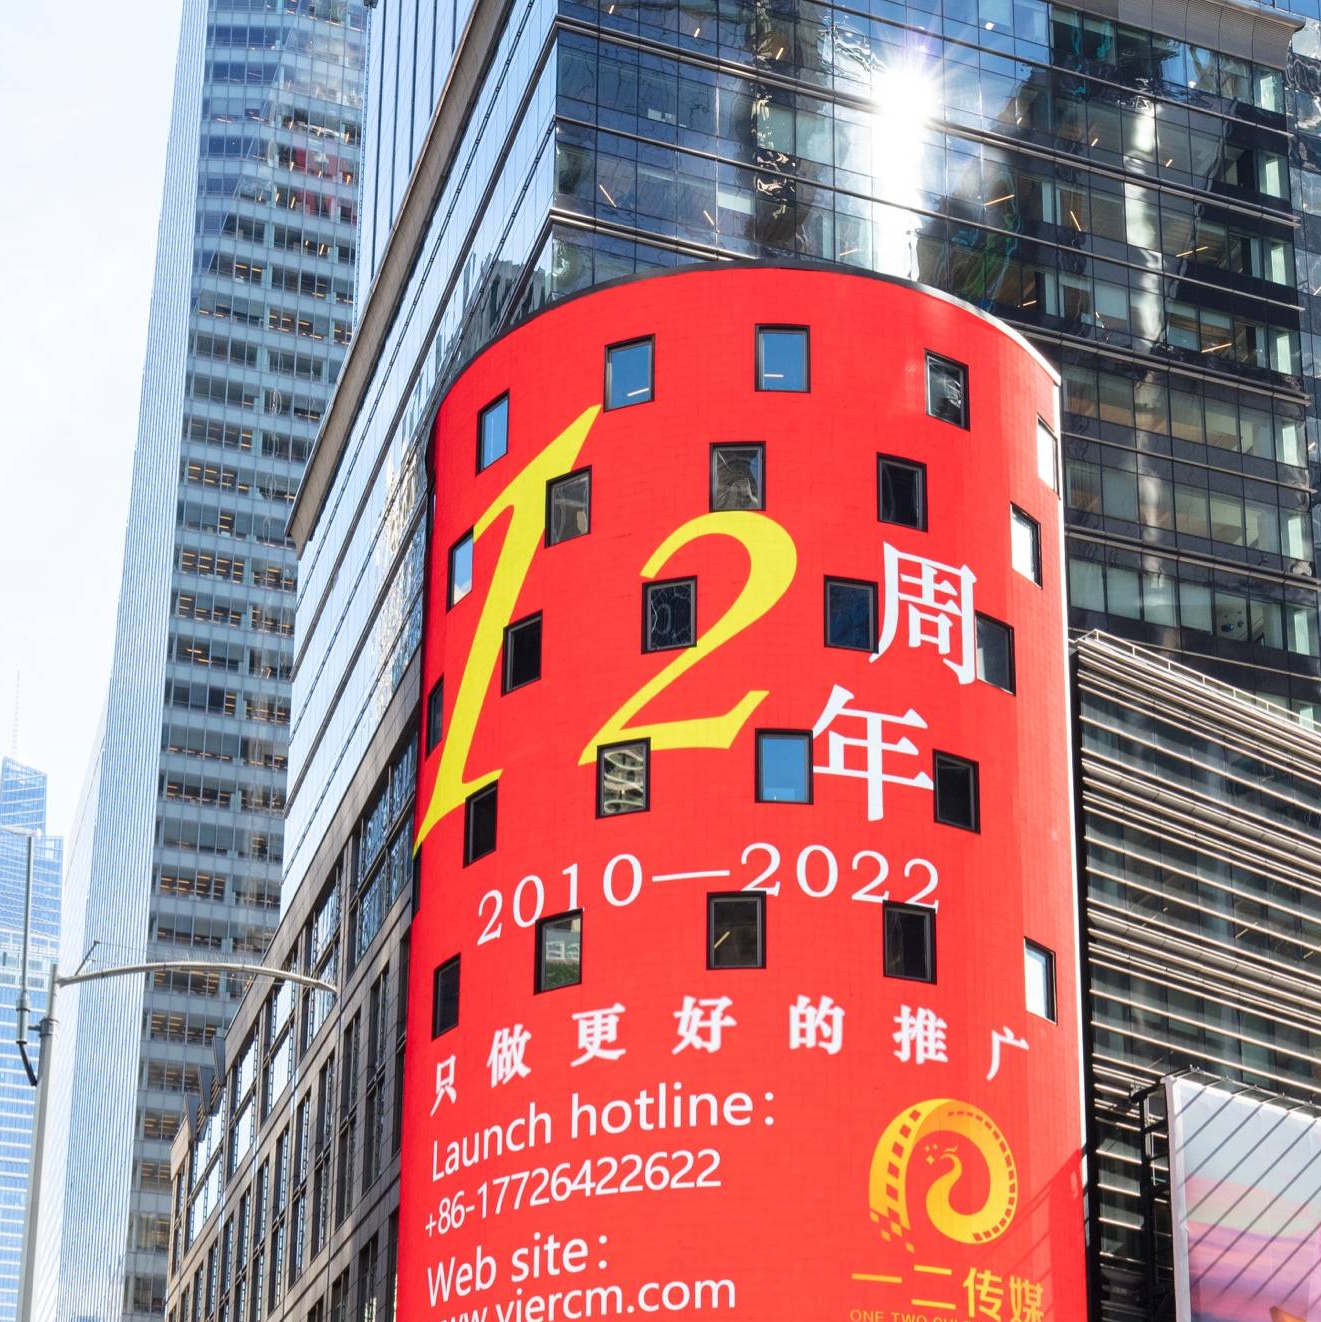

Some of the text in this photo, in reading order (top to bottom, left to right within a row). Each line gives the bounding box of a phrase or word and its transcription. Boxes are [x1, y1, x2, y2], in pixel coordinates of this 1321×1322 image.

[413, 404, 797, 857] 12
[430, 996, 1030, 1117] 只做更好的推广
[431, 1082, 775, 1182] Launch hotline:
[425, 1148, 722, 1238] +86-17726422622
[427, 1230, 608, 1307] Web site:
